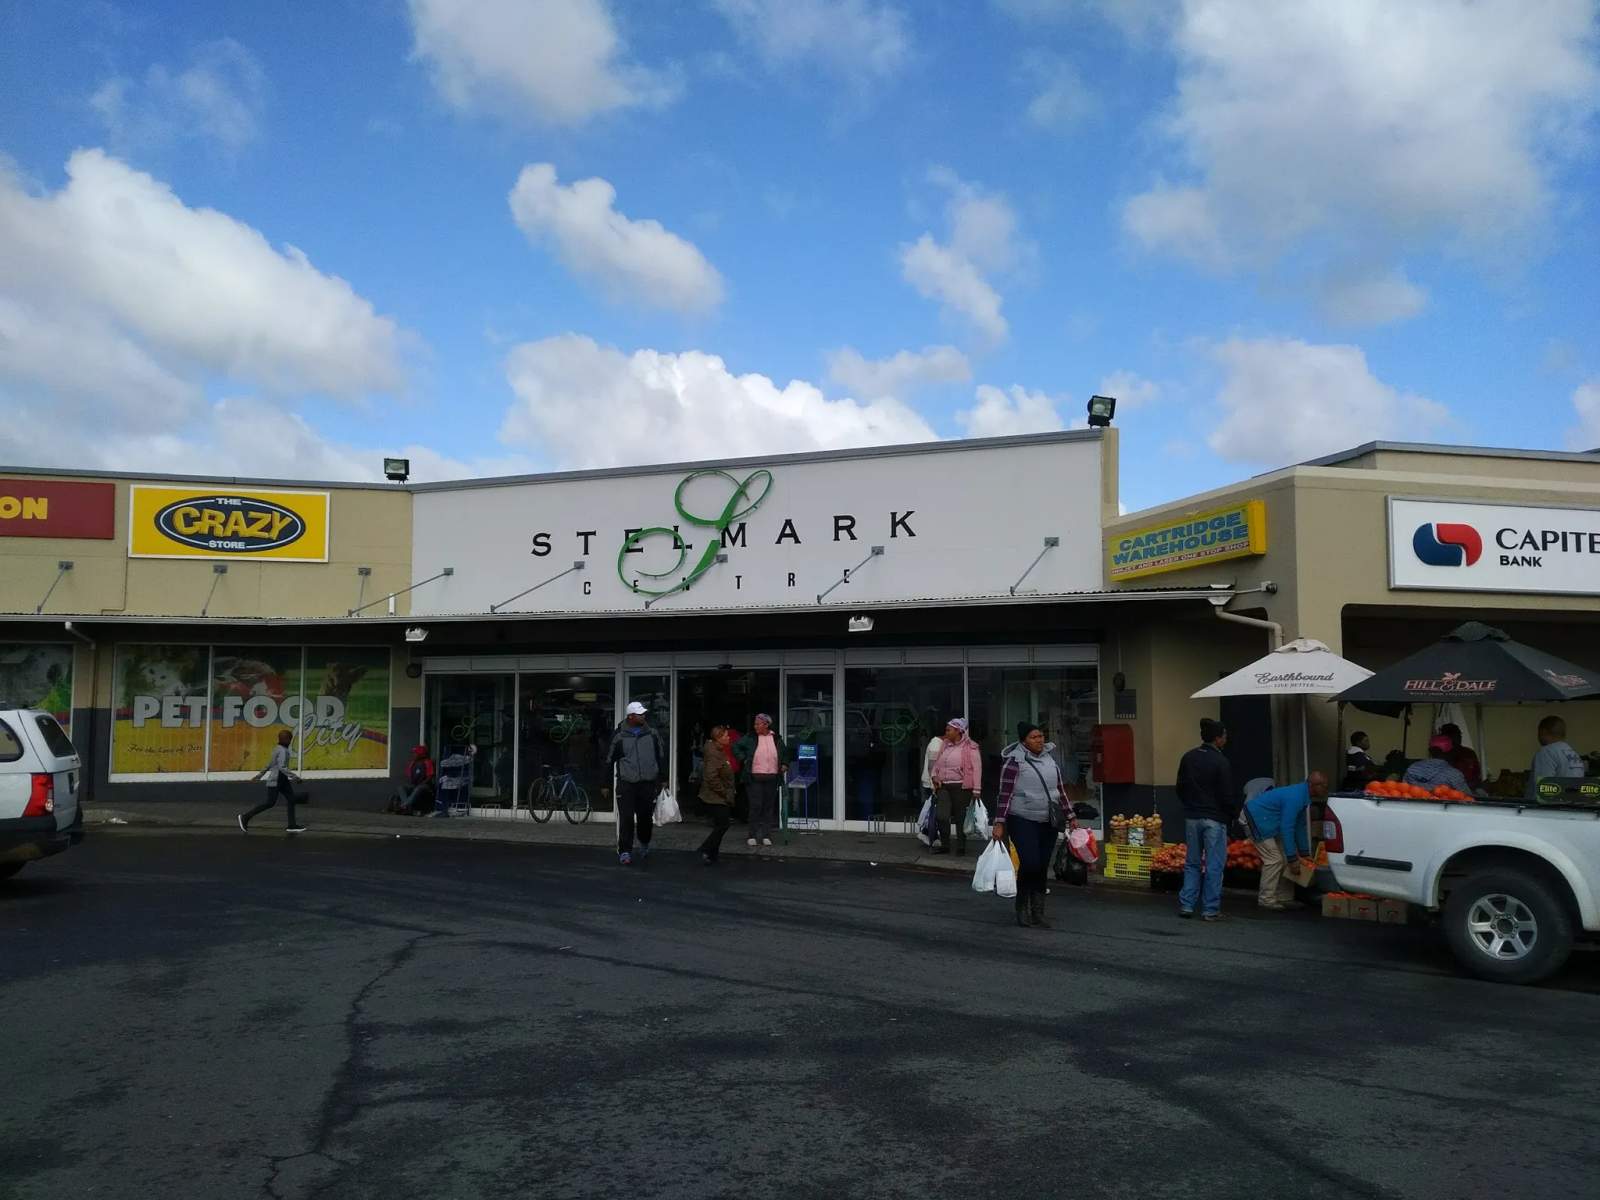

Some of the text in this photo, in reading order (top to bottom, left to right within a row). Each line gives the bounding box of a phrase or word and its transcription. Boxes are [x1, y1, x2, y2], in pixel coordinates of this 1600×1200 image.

[0, 497, 48, 520] ON
[172, 506, 293, 540] CRAZY
[531, 510, 916, 557] STELMARK
[1119, 511, 1242, 551] CARTRIDGE
[208, 540, 246, 549] STORE
[1112, 525, 1249, 565] WAREHOUSE
[1495, 528, 1600, 553] CAPITE
[1500, 555, 1542, 567] BANK
[1254, 672, 1335, 684] Earthbound
[1403, 680, 1440, 690] HILL
[1456, 680, 1496, 690] DALE
[132, 695, 345, 729] PET FOOD
[290, 713, 362, 753] City
[1540, 784, 1558, 793] Elite
[1581, 785, 1599, 794] Elite
